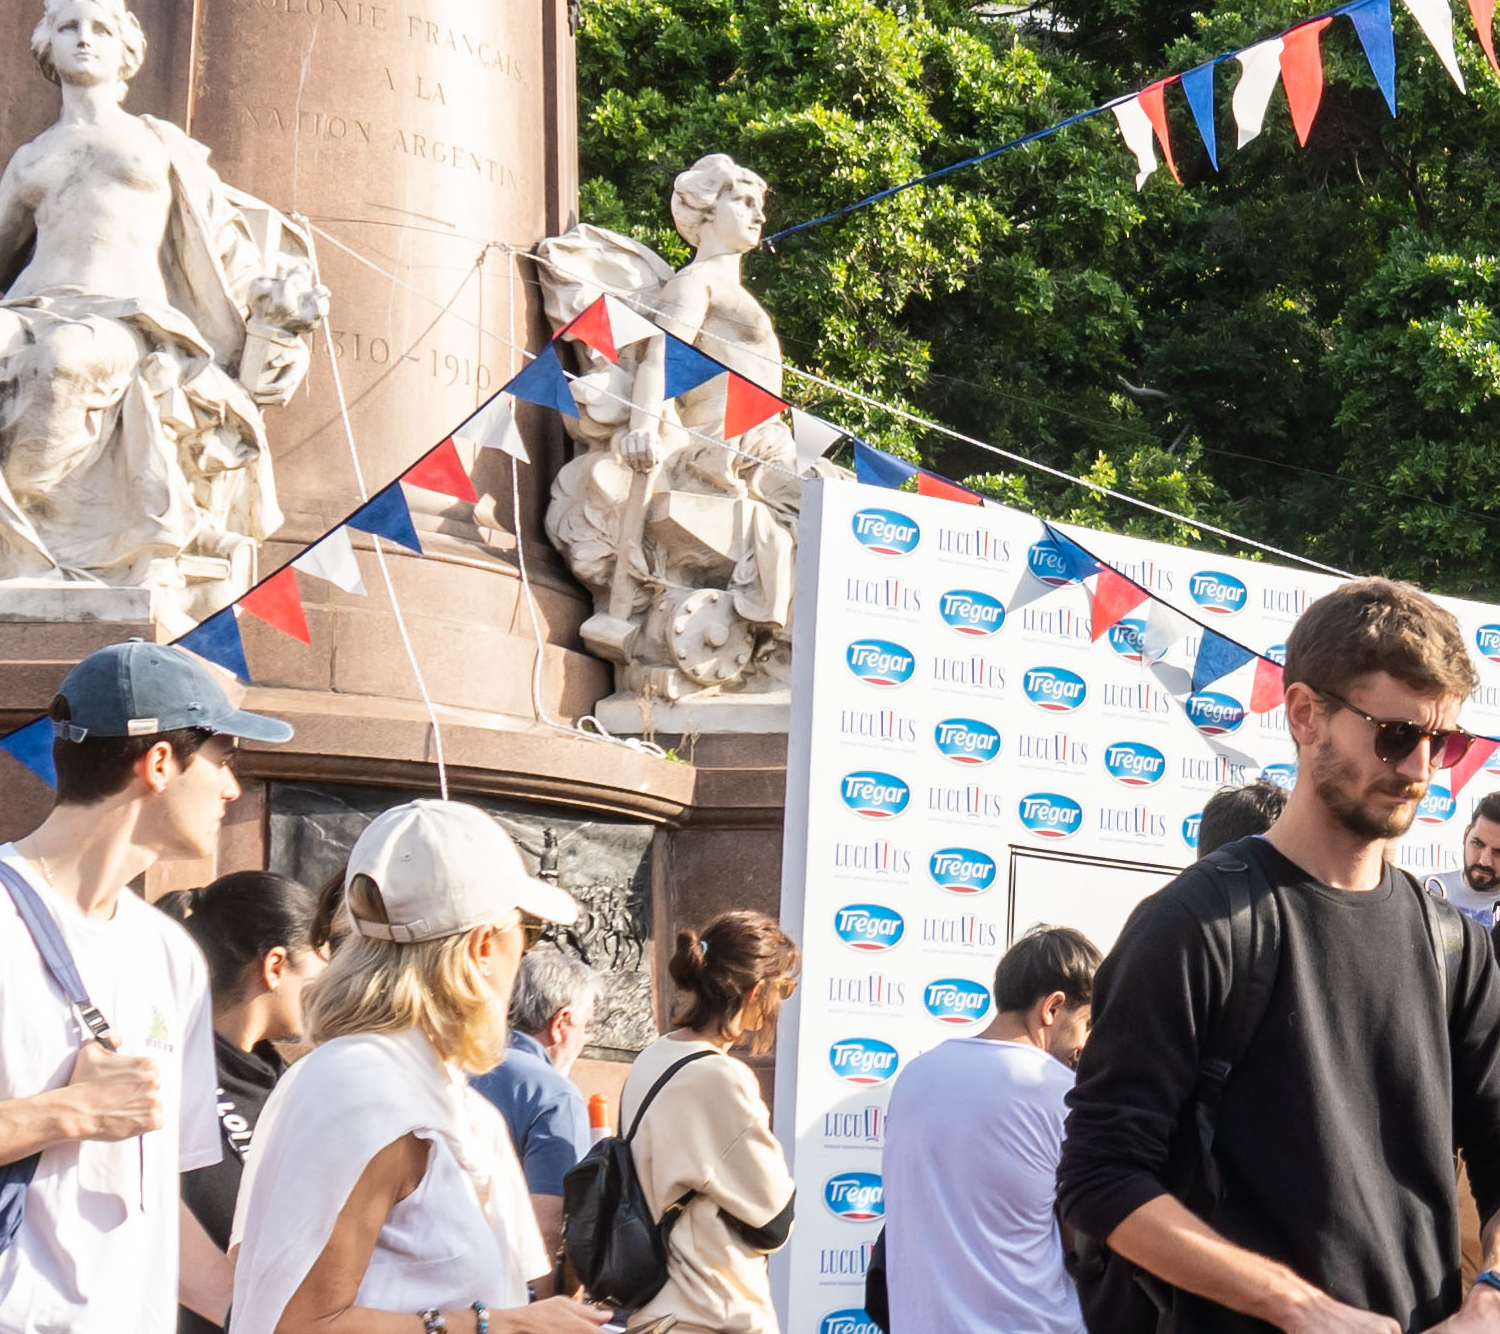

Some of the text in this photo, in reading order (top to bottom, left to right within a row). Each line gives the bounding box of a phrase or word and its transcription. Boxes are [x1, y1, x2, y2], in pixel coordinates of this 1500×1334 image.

[407, 14, 526, 87] FRANÇAIS
[416, 74, 447, 106] LA
[430, 348, 492, 391] 1910
[857, 513, 916, 543] Tregar
[1193, 576, 1244, 602] Tregar
[944, 595, 1002, 623] Tregar
[851, 644, 912, 674] Tregar
[1028, 671, 1083, 700] Tregar
[939, 723, 997, 752] Tregar
[1109, 747, 1163, 774] Tregar
[845, 777, 907, 806] Tregar
[1022, 798, 1079, 826] Tregar
[934, 853, 993, 881] Tregar
[839, 910, 901, 938] Tregar
[928, 984, 987, 1012] Tregar
[833, 1044, 896, 1071] Tregar
[824, 1108, 888, 1139] LUCULL
[830, 1180, 884, 1207] Trega
